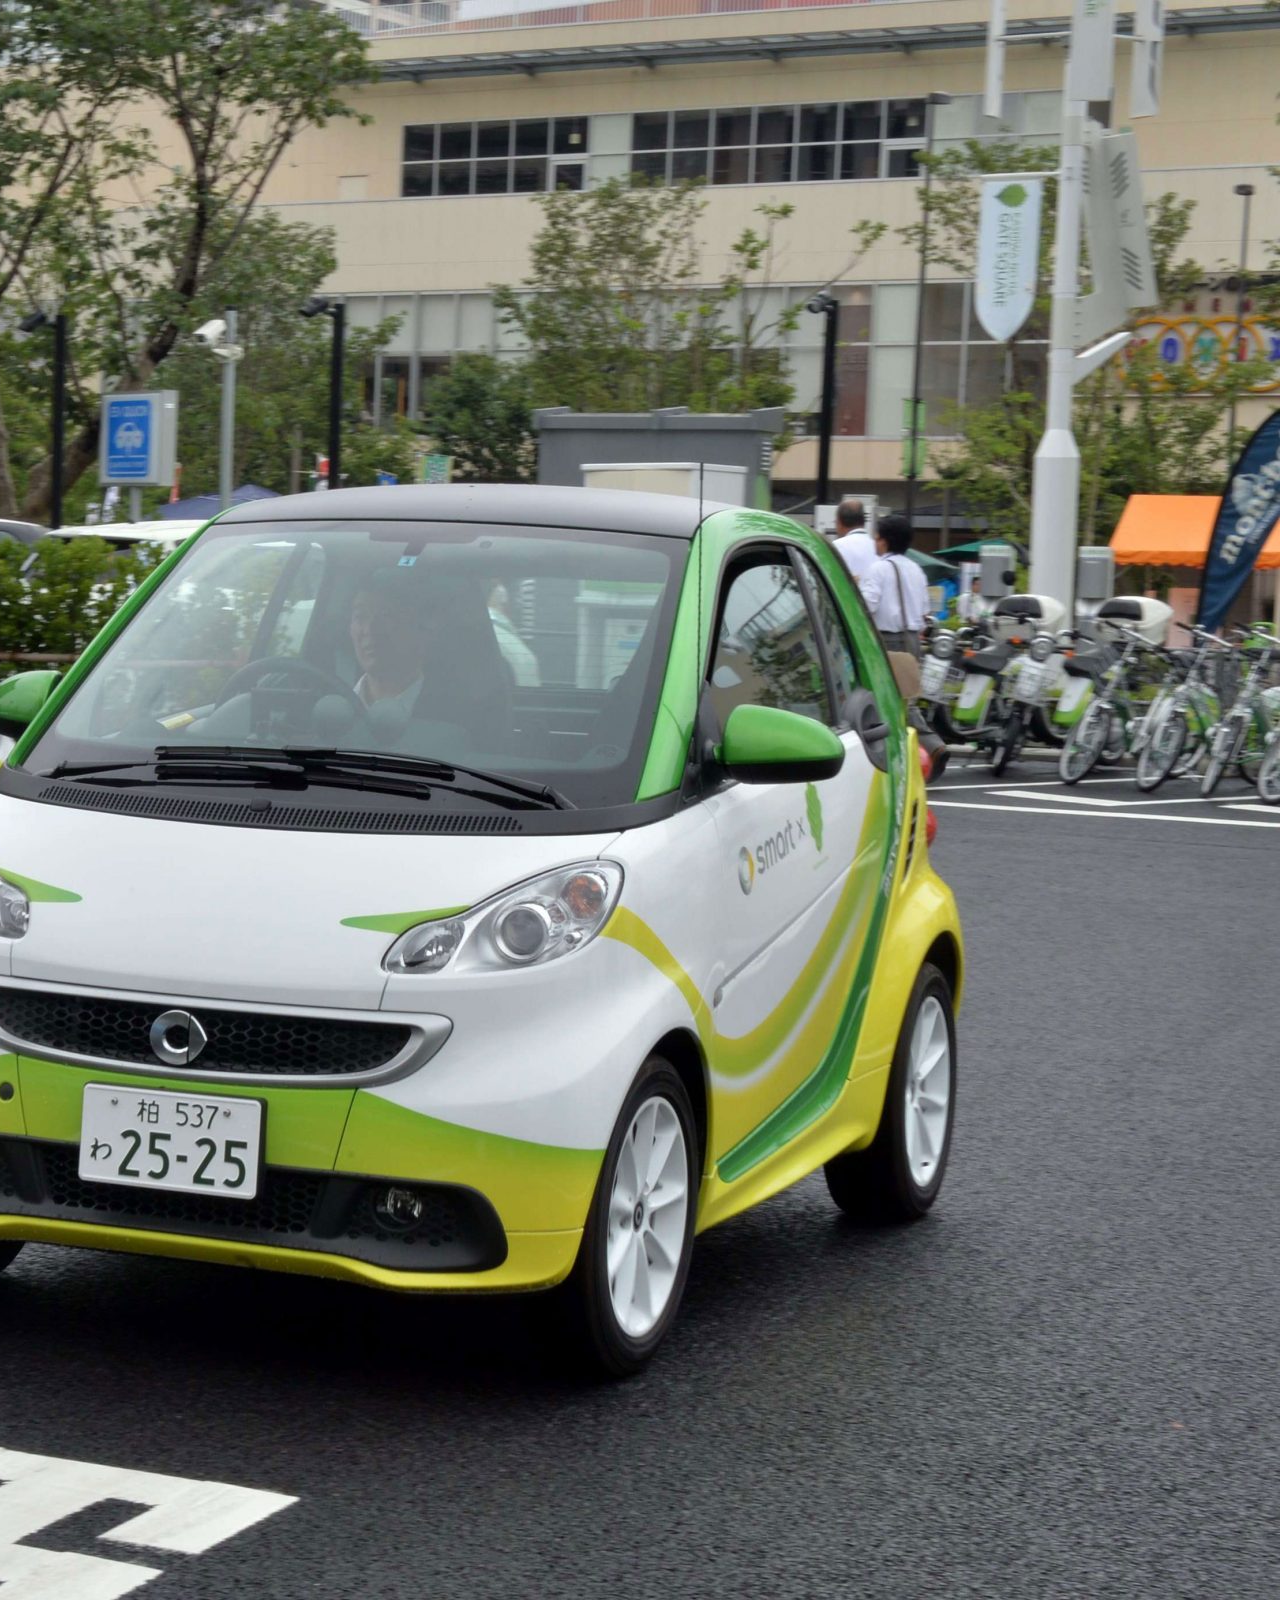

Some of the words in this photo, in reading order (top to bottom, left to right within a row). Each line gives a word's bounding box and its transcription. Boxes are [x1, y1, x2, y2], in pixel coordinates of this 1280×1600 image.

[996, 212, 1011, 249] GATE
[992, 252, 1010, 308] SQUARE
[755, 819, 796, 875] smart
[137, 1098, 160, 1124] 柏
[176, 1102, 219, 1130] 537
[90, 1137, 113, 1161] わ
[118, 1129, 248, 1189] 25-25
